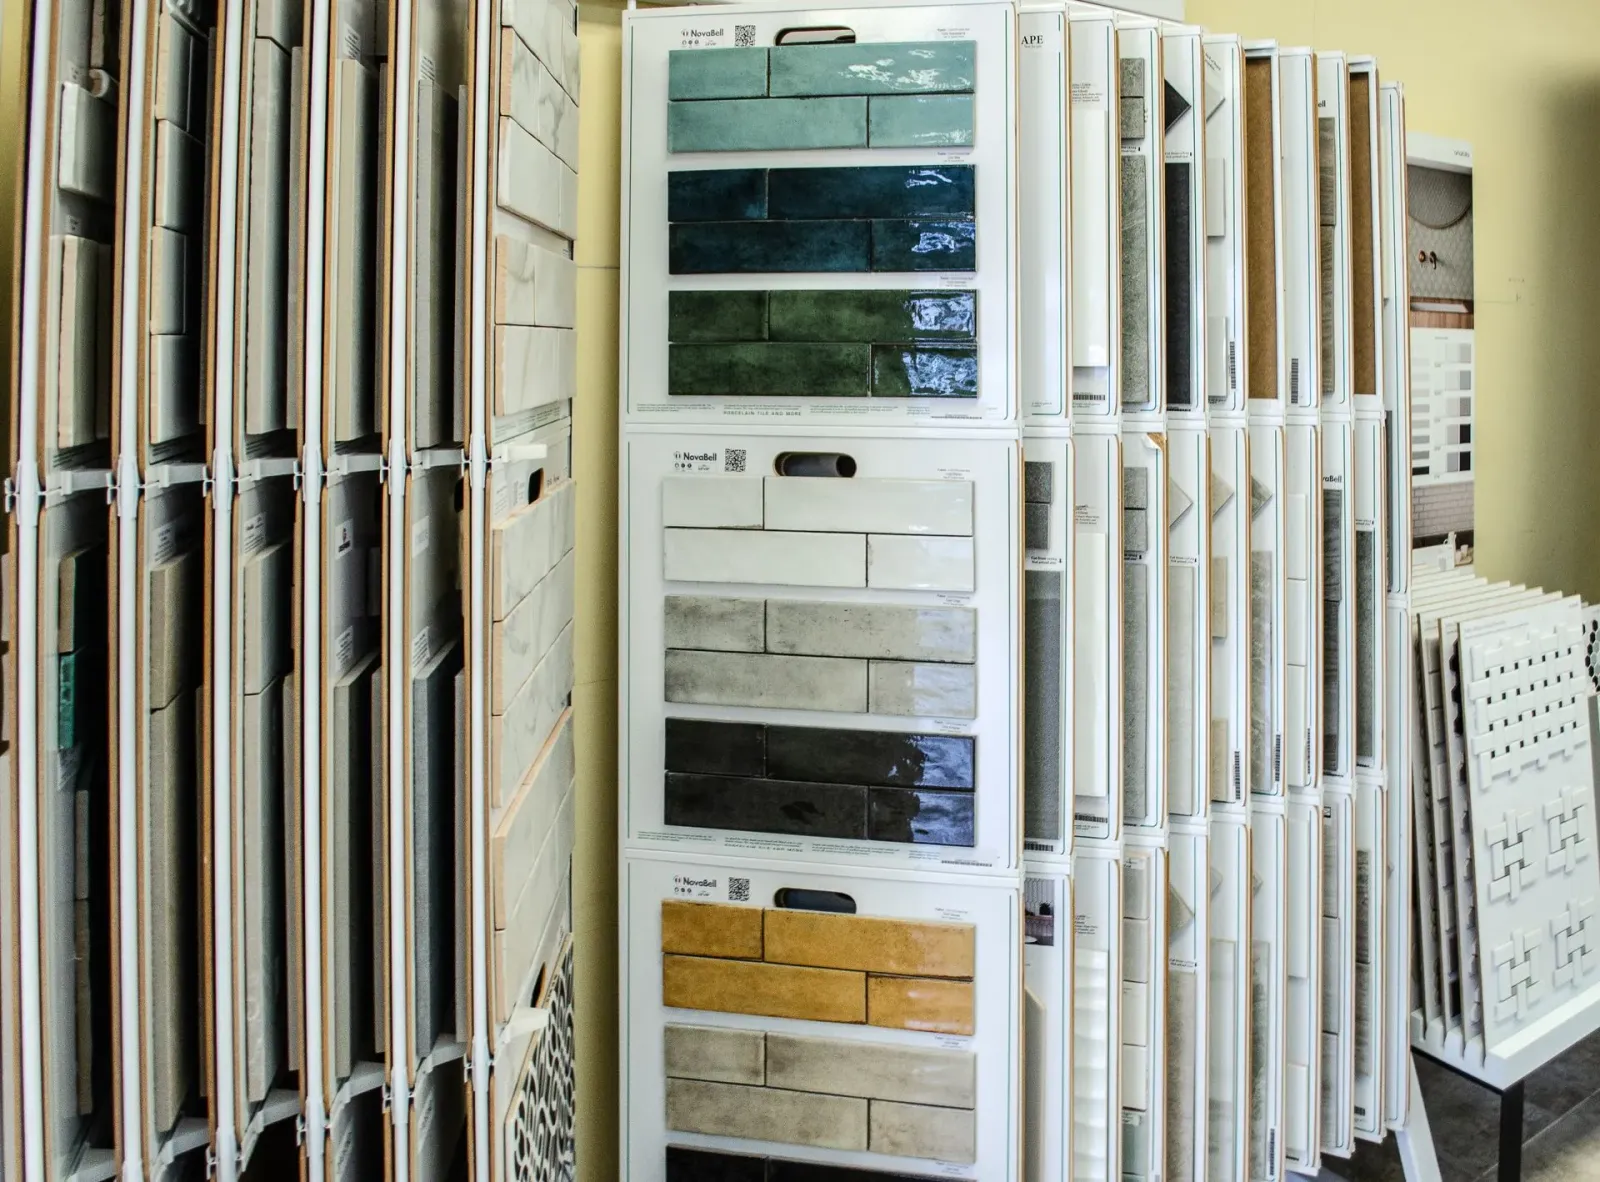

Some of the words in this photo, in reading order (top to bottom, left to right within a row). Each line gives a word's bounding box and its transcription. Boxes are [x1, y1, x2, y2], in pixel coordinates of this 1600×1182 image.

[690, 28, 724, 37] NovaBell
[1021, 35, 1044, 45] APE
[683, 452, 717, 461] NovaBell
[683, 877, 717, 888] NovaBell
